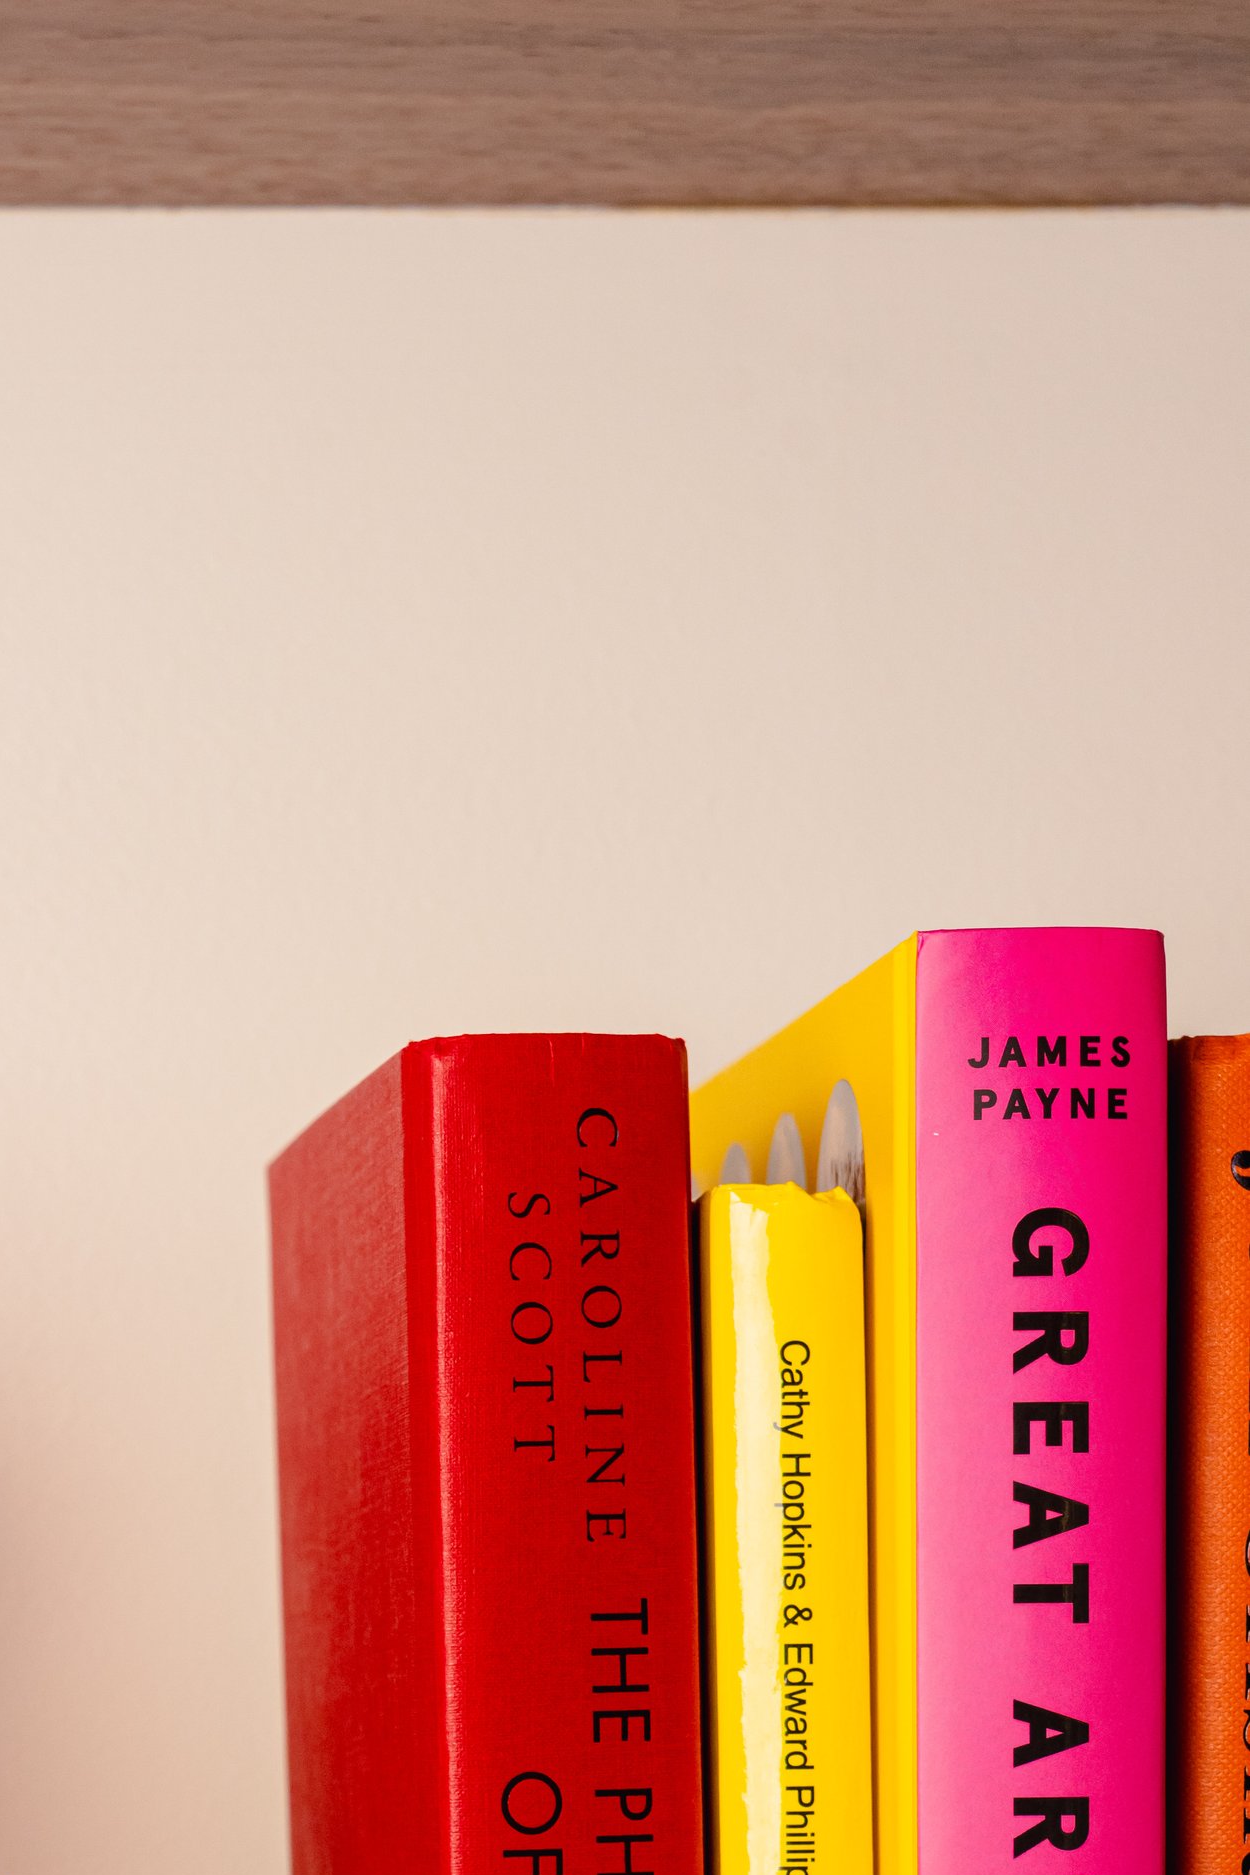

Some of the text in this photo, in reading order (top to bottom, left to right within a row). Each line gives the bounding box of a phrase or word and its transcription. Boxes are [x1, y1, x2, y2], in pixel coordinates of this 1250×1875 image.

[968, 1035, 1130, 1068] JAMES
[973, 1087, 1128, 1120] PAYNE
[507, 1192, 555, 1461] SCOTT
[576, 1107, 627, 1543] CAROLINE
[773, 1340, 811, 1440] Cathy
[1012, 1207, 1090, 1623] GREAT
[773, 1453, 812, 1591] Hopkins
[590, 1599, 650, 1742] THE
[783, 1605, 812, 1627] &
[783, 1643, 814, 1770] Edward
